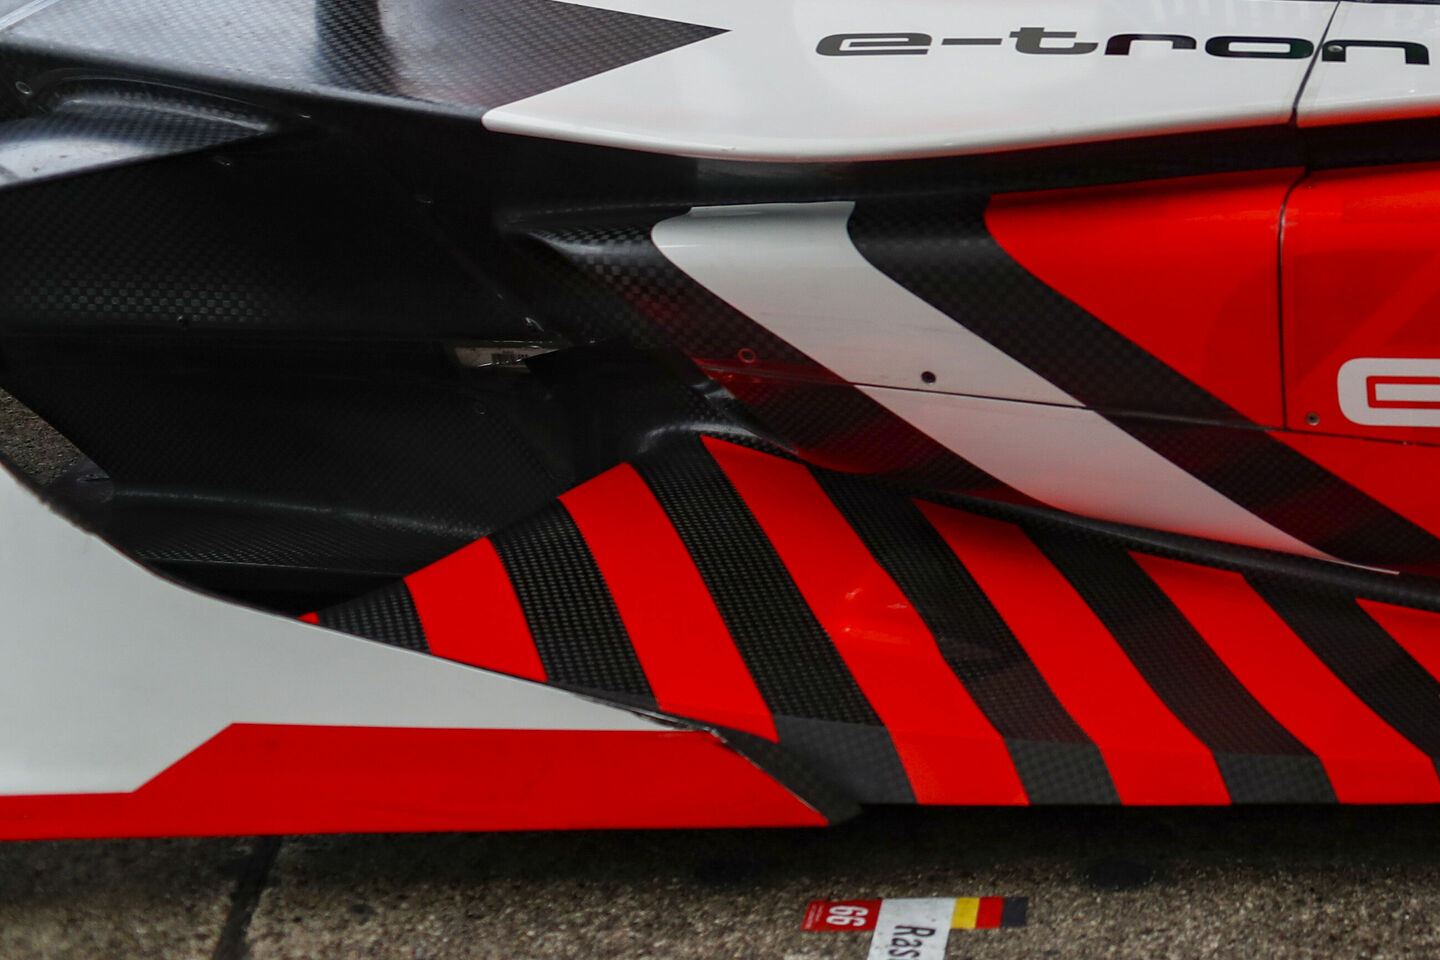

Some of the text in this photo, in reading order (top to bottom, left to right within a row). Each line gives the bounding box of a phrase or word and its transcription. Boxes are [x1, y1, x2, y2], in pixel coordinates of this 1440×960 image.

[815, 26, 1431, 66] e-tron
[825, 904, 870, 928] 66
[886, 924, 936, 960] Ras
